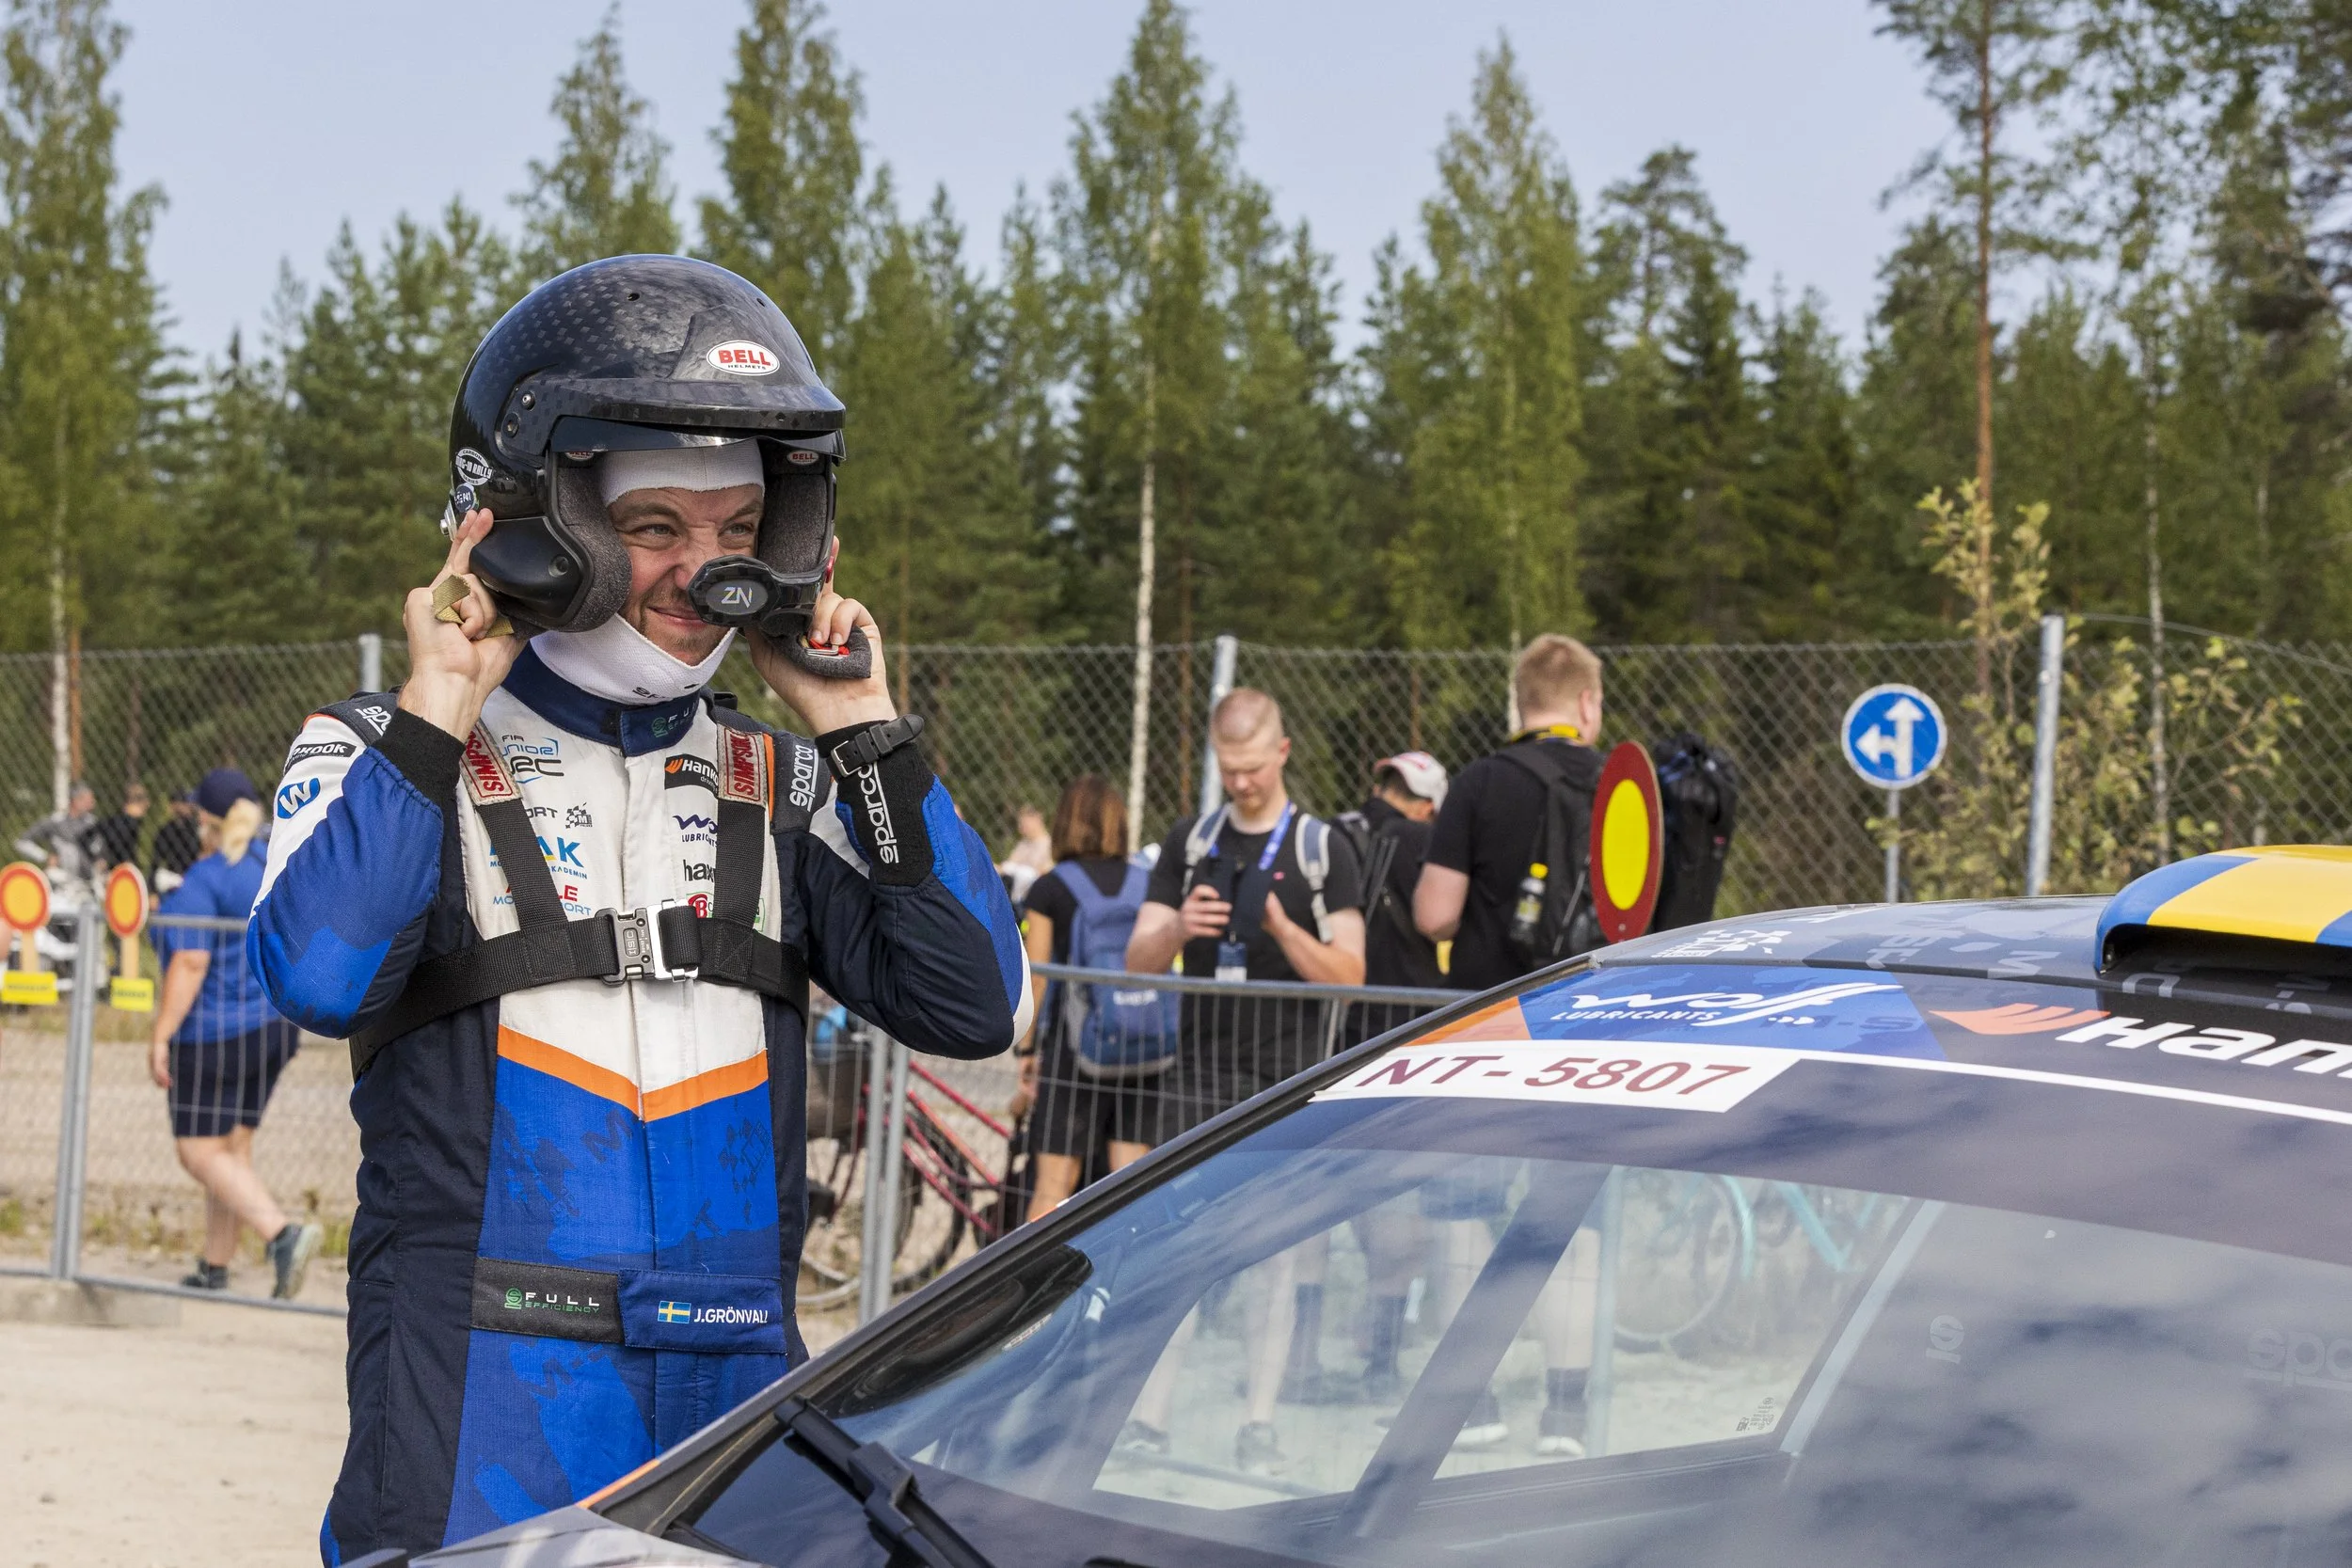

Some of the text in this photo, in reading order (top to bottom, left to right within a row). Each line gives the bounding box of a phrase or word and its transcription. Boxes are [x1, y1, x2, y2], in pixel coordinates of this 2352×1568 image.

[718, 349, 771, 367] BELL
[721, 586, 753, 609] ZN
[501, 735, 525, 743] FIA
[730, 731, 756, 797] SIMPSON
[789, 744, 818, 813] sparco
[550, 865, 588, 879] KADEMIN
[1550, 1010, 1723, 1022] LUBRICANTS
[2055, 1016, 2352, 1078] Han
[525, 1291, 600, 1307] FULL
[525, 1301, 600, 1314] EFFICIENCY
